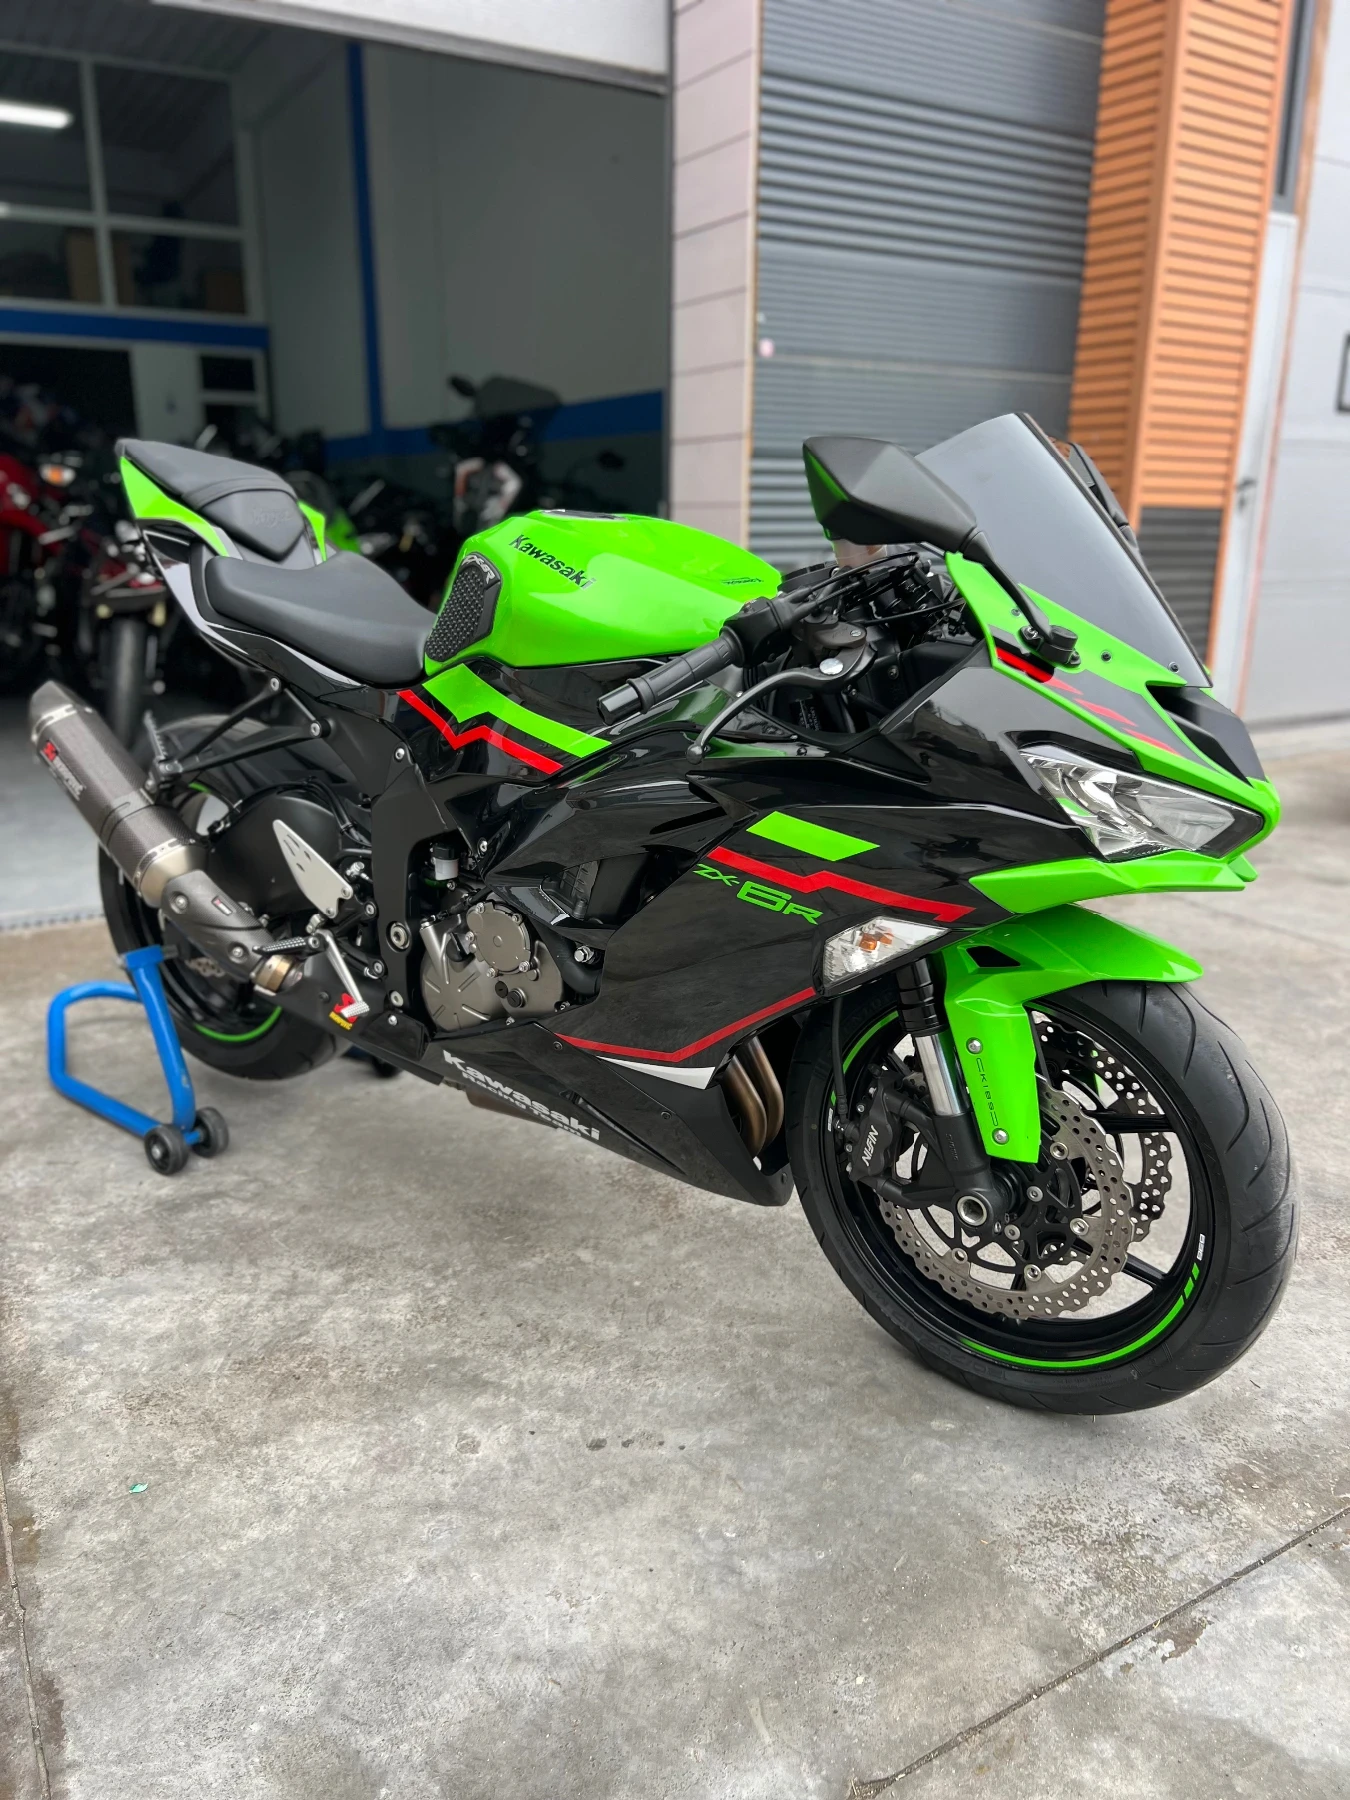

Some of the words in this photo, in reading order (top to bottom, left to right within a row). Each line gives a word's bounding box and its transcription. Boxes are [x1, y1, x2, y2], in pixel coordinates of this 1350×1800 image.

[509, 534, 597, 590] Kawasaki
[693, 863, 823, 925] ZX-6R
[443, 1050, 600, 1141] Kawasaki
[462, 1071, 527, 1110] Racing
[530, 1106, 582, 1137] Team
